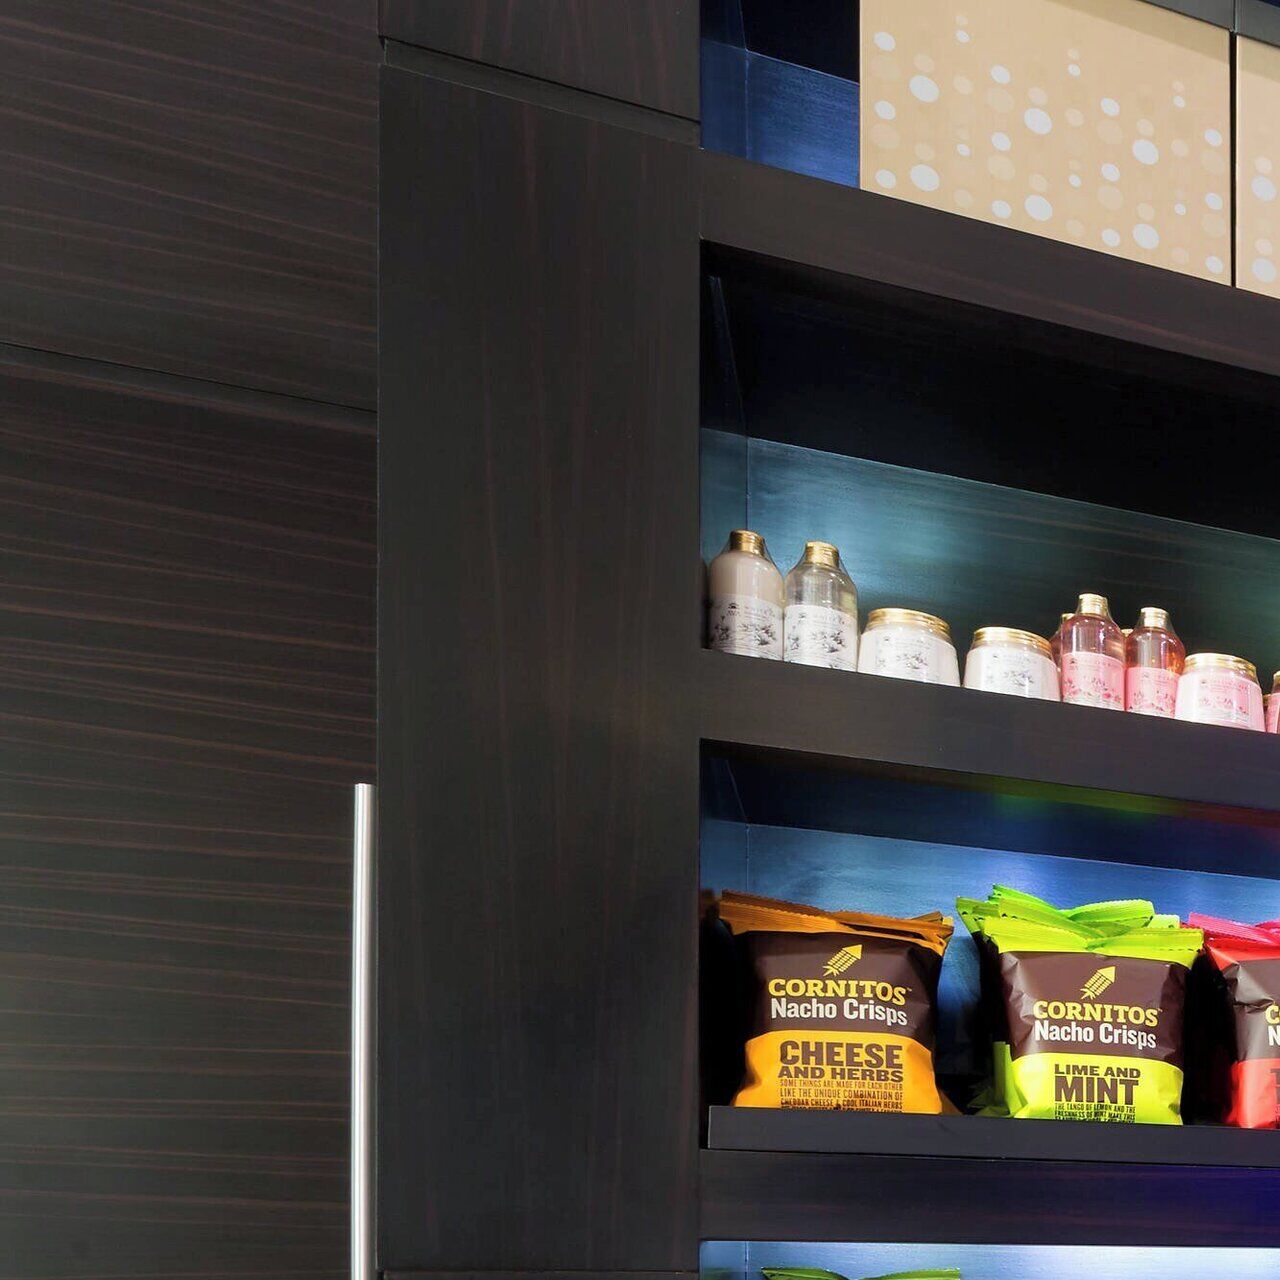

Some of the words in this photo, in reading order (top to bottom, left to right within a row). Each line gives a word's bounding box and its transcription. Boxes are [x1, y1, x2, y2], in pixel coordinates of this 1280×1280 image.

[768, 978, 907, 1006] CORNITOS
[771, 998, 837, 1019] Nacho
[843, 998, 908, 1026] Crisps
[1033, 1000, 1158, 1027] CORNITOS
[1034, 1020, 1094, 1042] Nacho
[1099, 1023, 1157, 1050] Crisps
[779, 1040, 903, 1069] CHEESE
[778, 1066, 825, 1079] AND
[831, 1067, 904, 1083] HERBS
[799, 1080, 821, 1088] THINGS
[1054, 1063, 1100, 1076] LIME
[1104, 1066, 1141, 1079] AND
[780, 1088, 796, 1097] LIKE
[799, 1088, 812, 1097] THE
[814, 1088, 841, 1098] UNIQUE
[843, 1089, 893, 1100] COMBINATION
[1054, 1075, 1139, 1106] MINT
